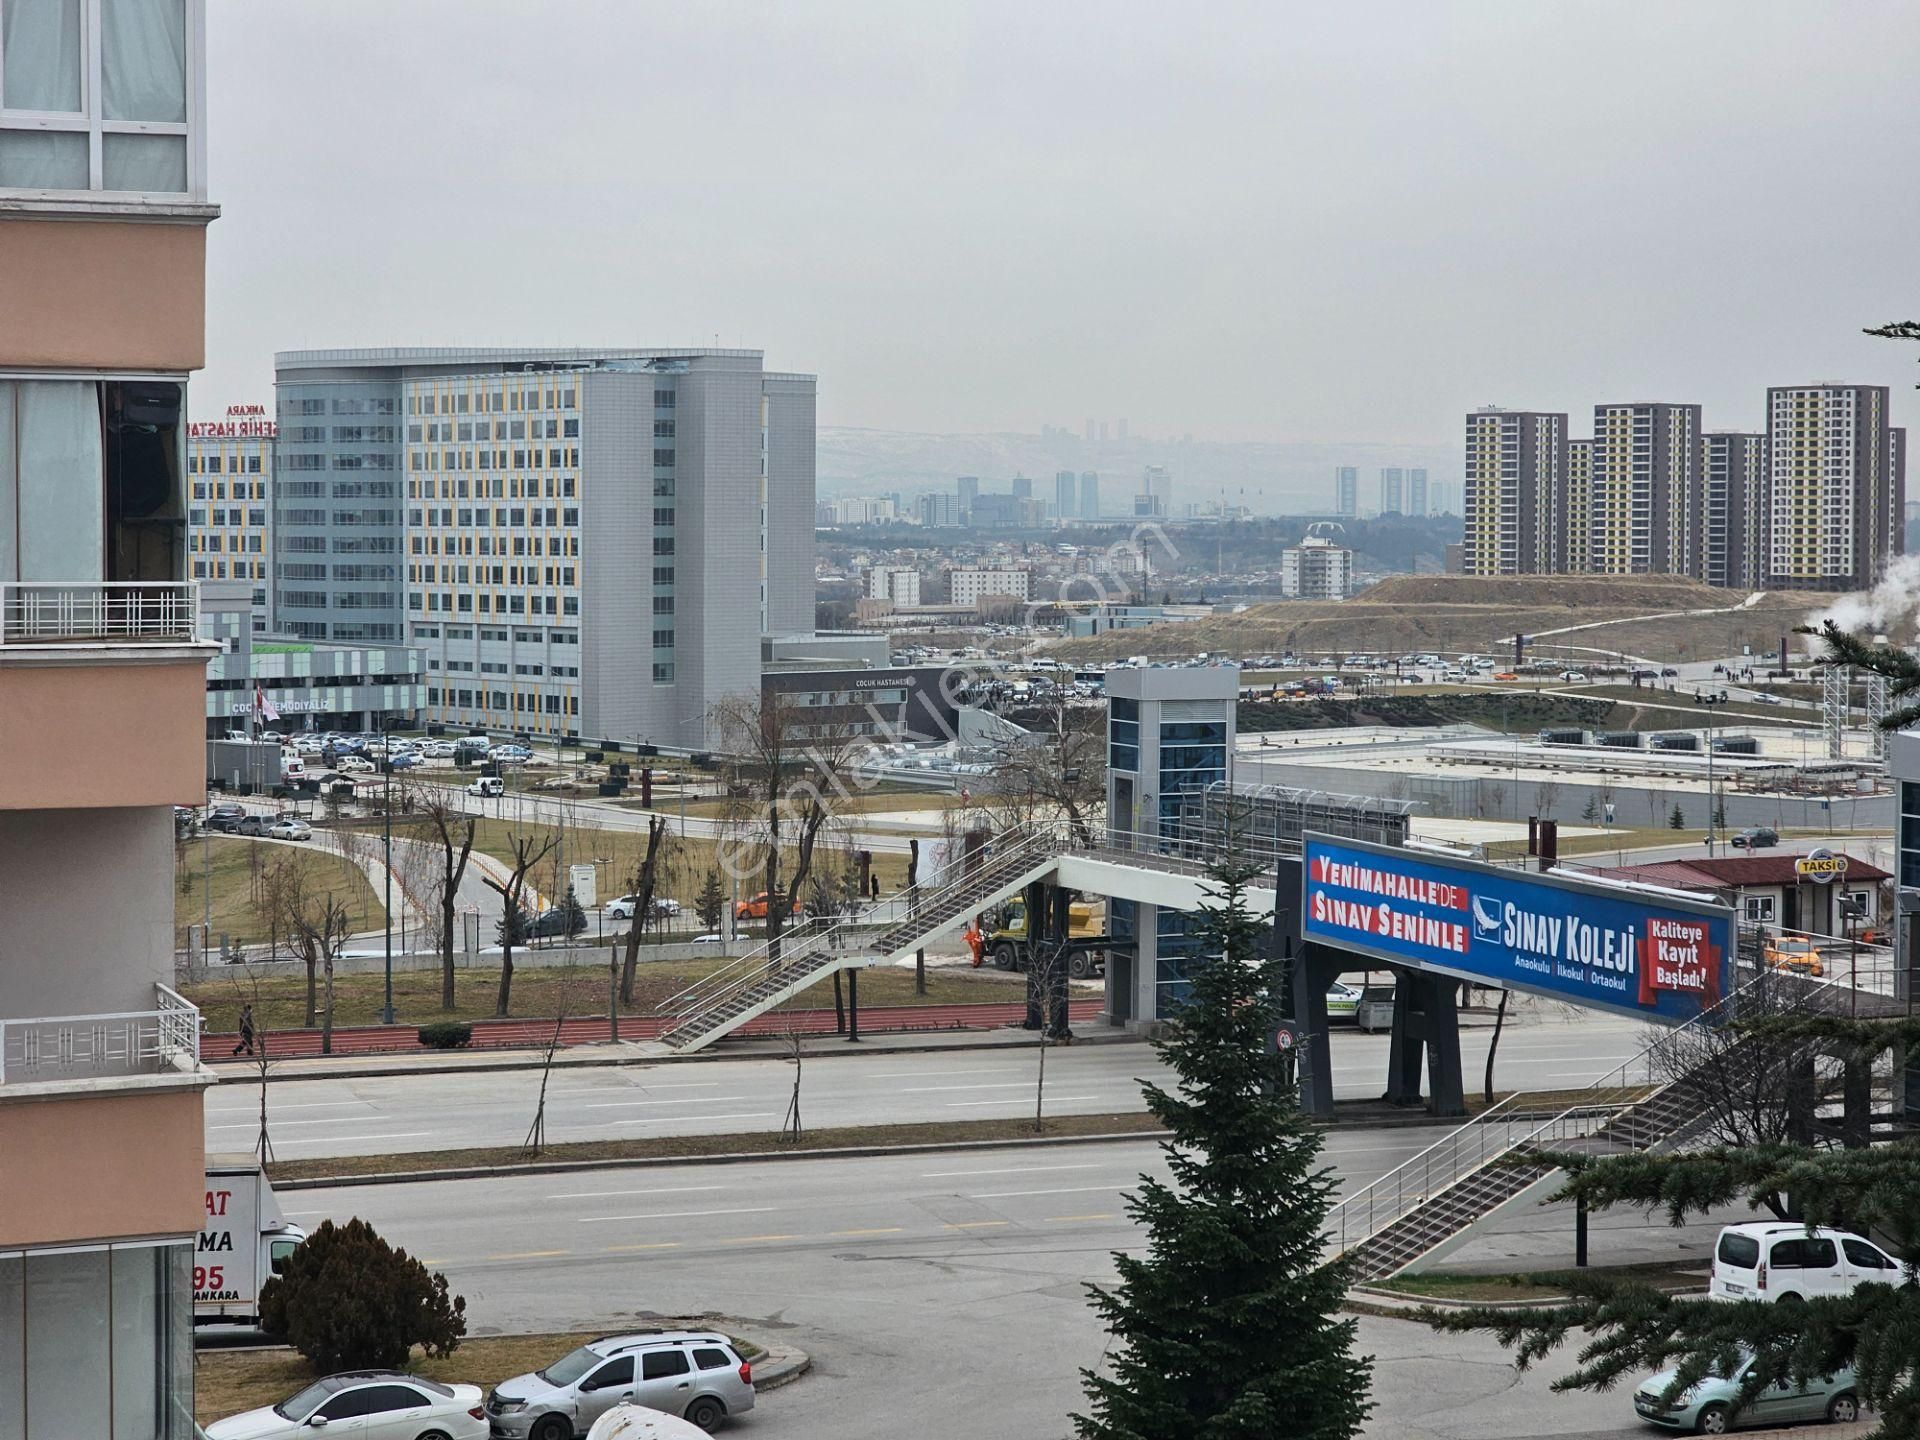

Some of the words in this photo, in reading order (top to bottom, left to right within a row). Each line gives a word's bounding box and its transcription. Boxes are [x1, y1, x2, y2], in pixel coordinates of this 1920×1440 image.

[1803, 861, 1836, 871] TAKSİ
[1315, 890, 1373, 932] SINAV
[1377, 902, 1464, 953] SENİNLE
[1652, 920, 1703, 942] Kaliteye
[1504, 902, 1561, 957] SINAV
[1566, 915, 1635, 974] KOLEJİ
[1515, 954, 1550, 974] Anaokulu
[1591, 977, 1626, 991] Ortaokul
[1656, 967, 1707, 990] Başladı!
